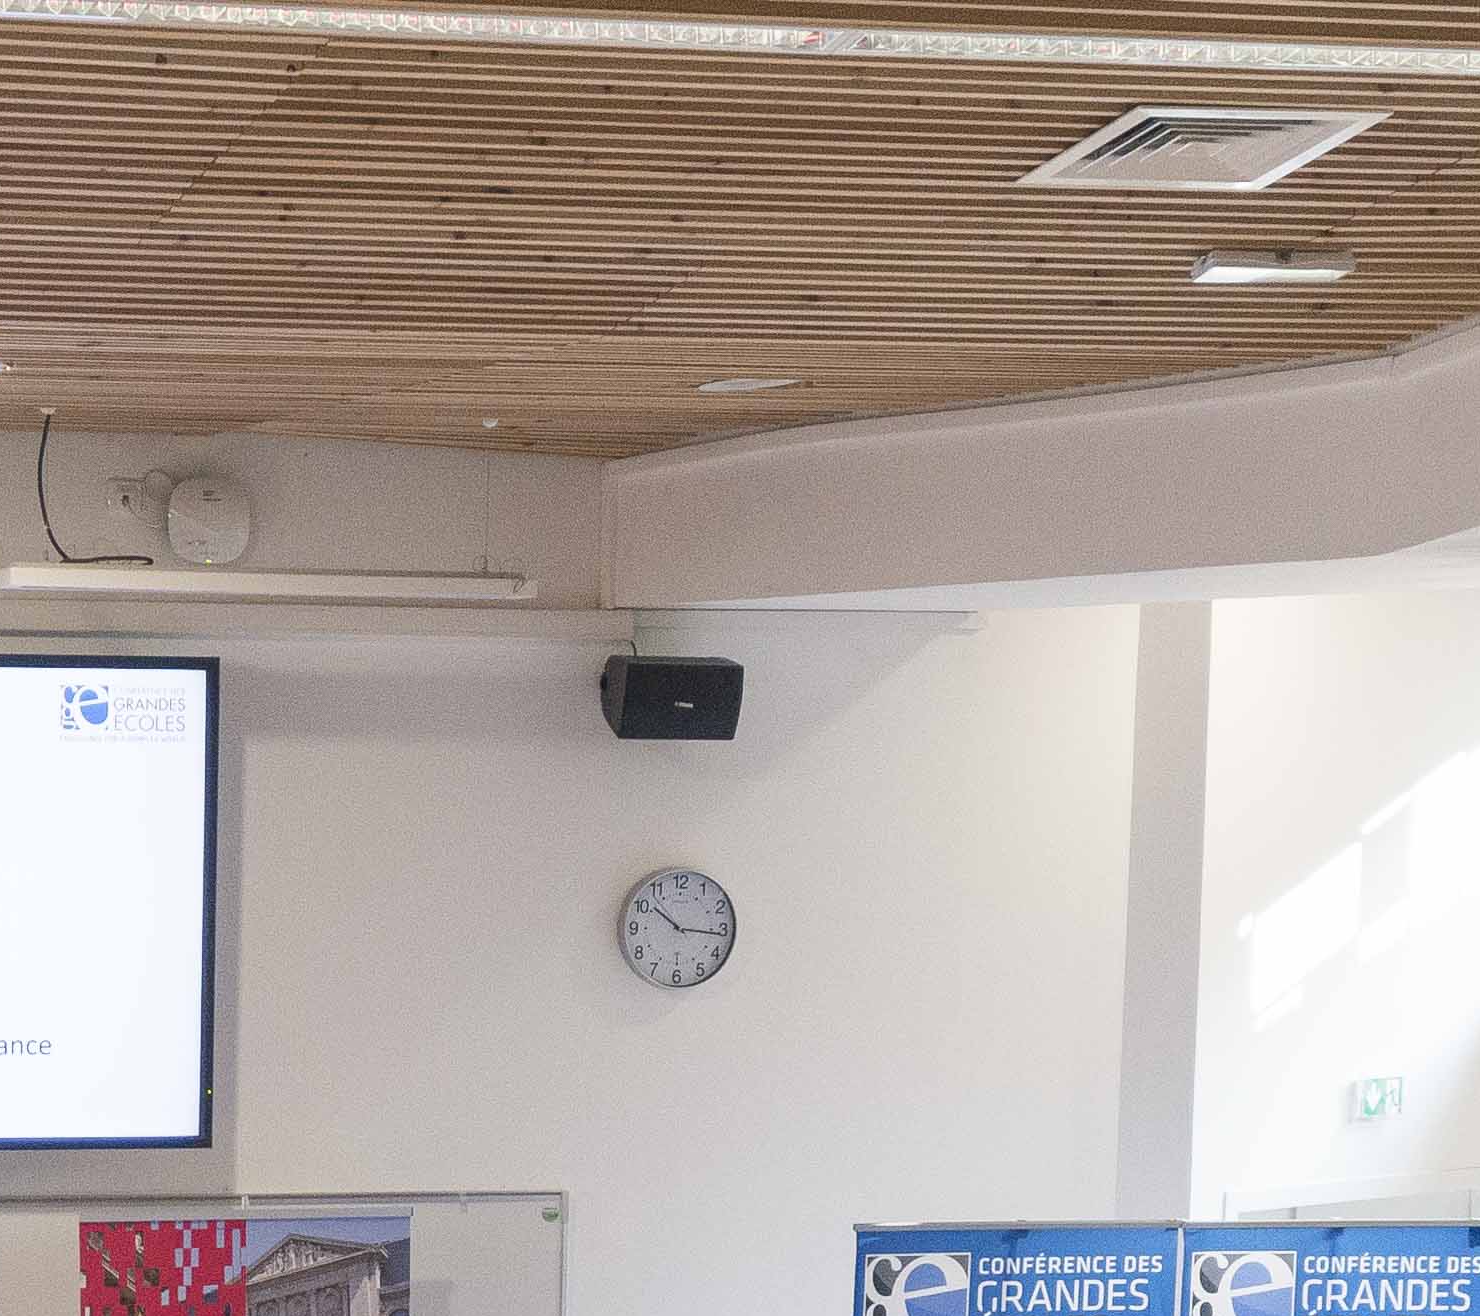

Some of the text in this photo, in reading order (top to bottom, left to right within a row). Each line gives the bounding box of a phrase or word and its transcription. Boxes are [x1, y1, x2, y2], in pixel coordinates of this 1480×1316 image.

[113, 697, 186, 712] GRANDES
[650, 882, 663, 896] 11
[673, 875, 689, 889] 12
[699, 883, 706, 896] 1
[634, 900, 650, 914] 10
[715, 900, 726, 914] 2
[629, 921, 639, 935] 9
[718, 923, 728, 937] 3
[634, 945, 643, 960] 8
[711, 945, 720, 960] 4
[650, 963, 659, 976] 7
[672, 969, 682, 984] 6
[696, 963, 705, 976] 5
[978, 1253, 1163, 1274] CONFÉRENCE DES
[1304, 1253, 1439, 1274] CONFÉRENCE
[977, 1278, 1149, 1312] GRANDES
[1302, 1279, 1471, 1312] GRANDES
